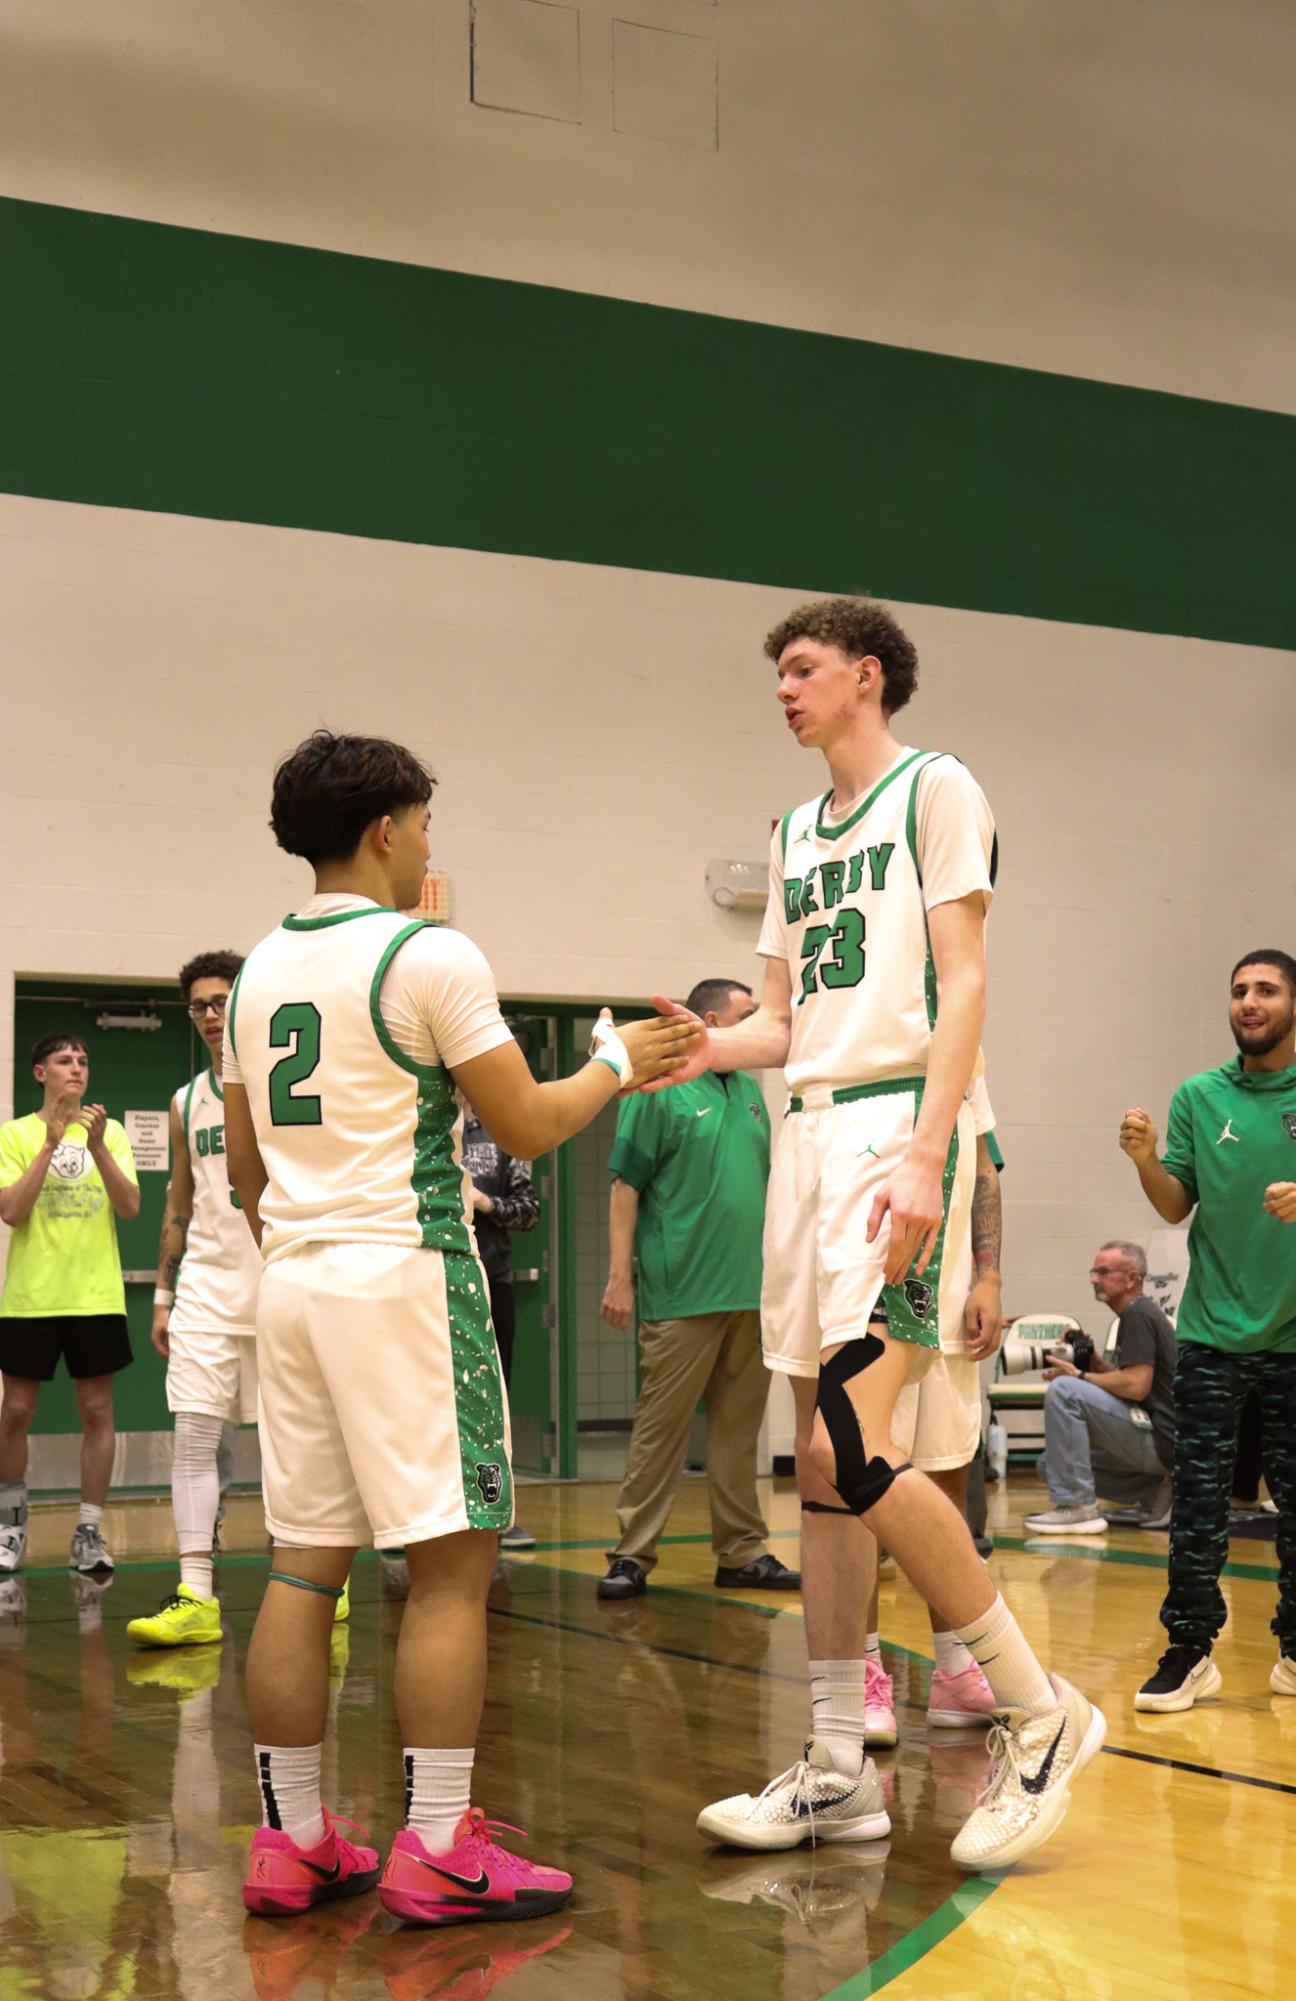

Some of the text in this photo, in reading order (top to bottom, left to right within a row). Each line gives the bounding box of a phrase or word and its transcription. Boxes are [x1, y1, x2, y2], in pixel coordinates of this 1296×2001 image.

[784, 843, 895, 925] DERBY
[798, 907, 866, 1006] 23
[269, 1001, 323, 1127] 2
[1018, 1323, 1071, 1340] PANTHER
